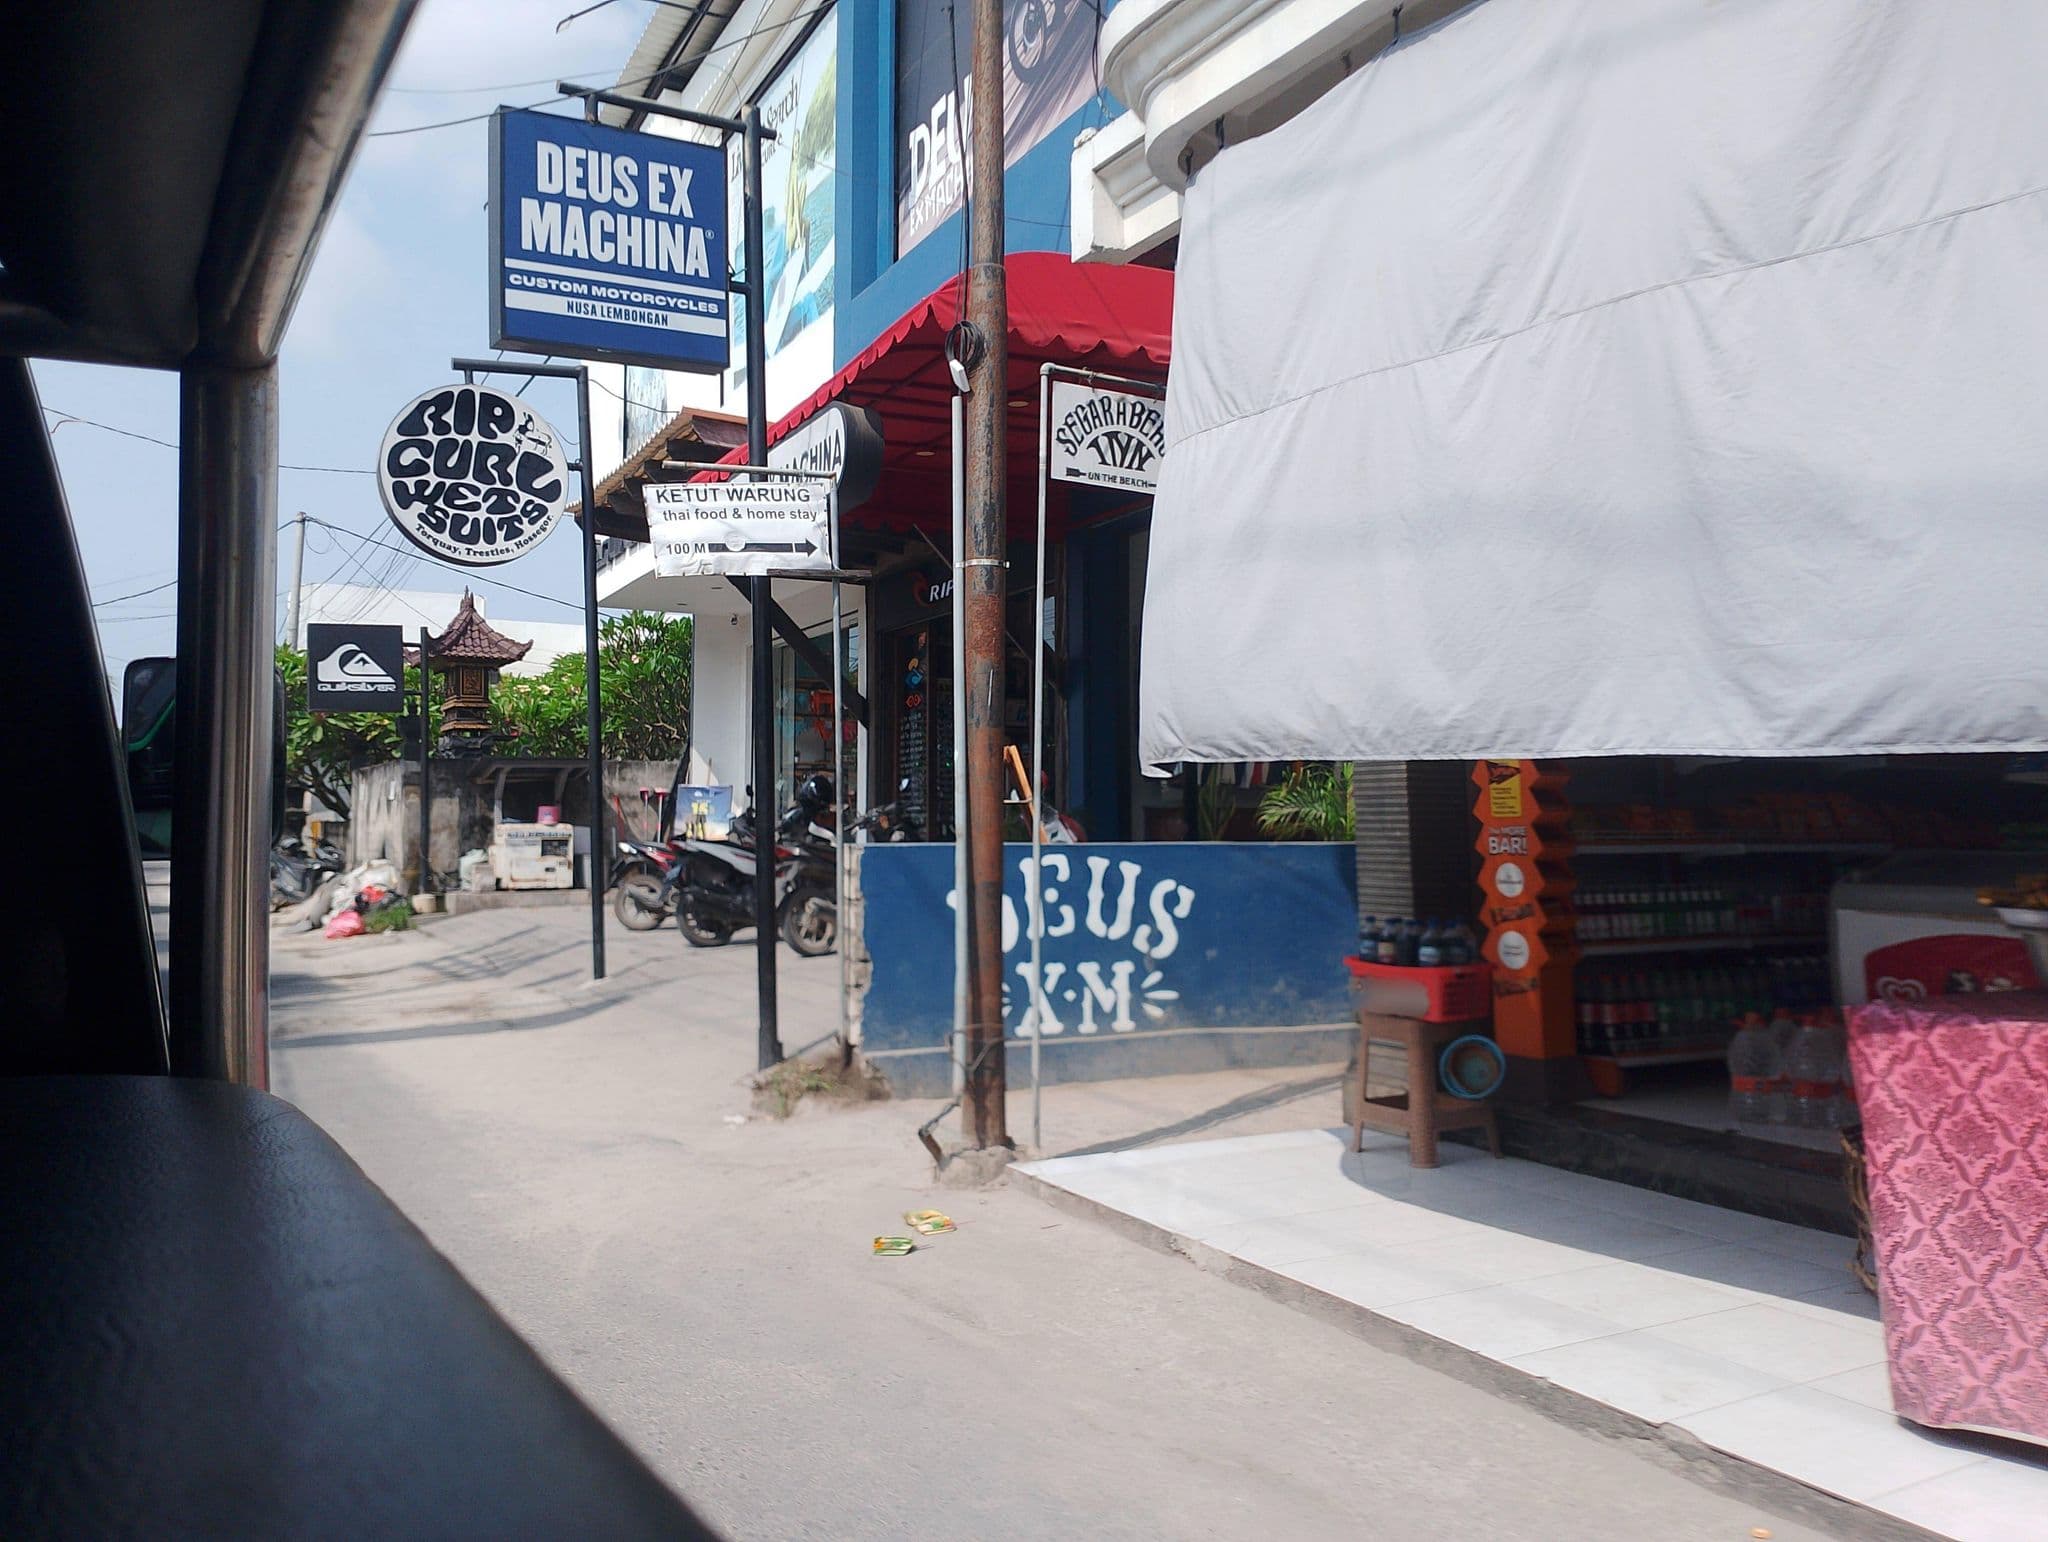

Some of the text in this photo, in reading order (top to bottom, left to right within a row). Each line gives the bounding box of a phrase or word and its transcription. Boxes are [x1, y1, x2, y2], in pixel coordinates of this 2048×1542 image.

[537, 140, 639, 208] DEUS
[648, 161, 694, 218] EX
[509, 274, 719, 314] CUSTOM MOTORCYCLES
[567, 300, 669, 327] NUSA LEMBONGAN
[396, 388, 516, 440] RIP
[387, 437, 562, 503] CURL
[1102, 473, 1118, 483] THE
[1119, 476, 1148, 488] BEACH
[655, 488, 811, 504] KETUT WARUNG
[662, 508, 818, 522] thai food & home stay
[666, 542, 706, 555] 100 M
